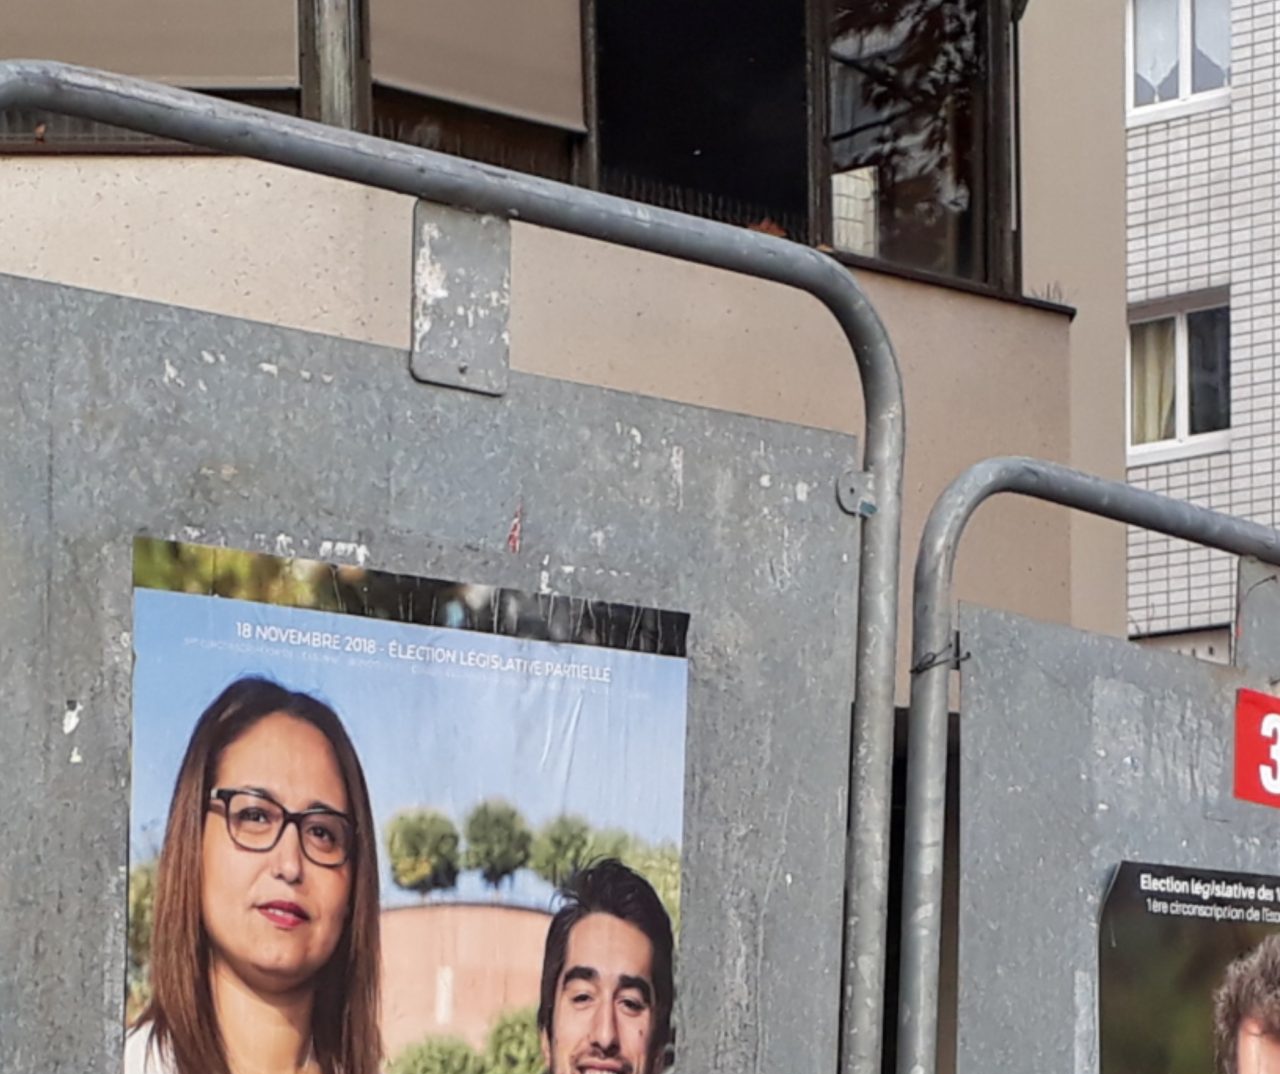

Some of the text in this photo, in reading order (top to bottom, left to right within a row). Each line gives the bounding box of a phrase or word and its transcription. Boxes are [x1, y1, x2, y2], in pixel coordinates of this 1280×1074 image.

[236, 621, 252, 640] 18
[255, 627, 341, 652] NOVEMBRE
[344, 636, 376, 656] 2018
[388, 640, 457, 665] ÉLECTION
[545, 662, 611, 684] PARTIELLE
[1140, 873, 1189, 894] Election
[1246, 906, 1260, 920] de
